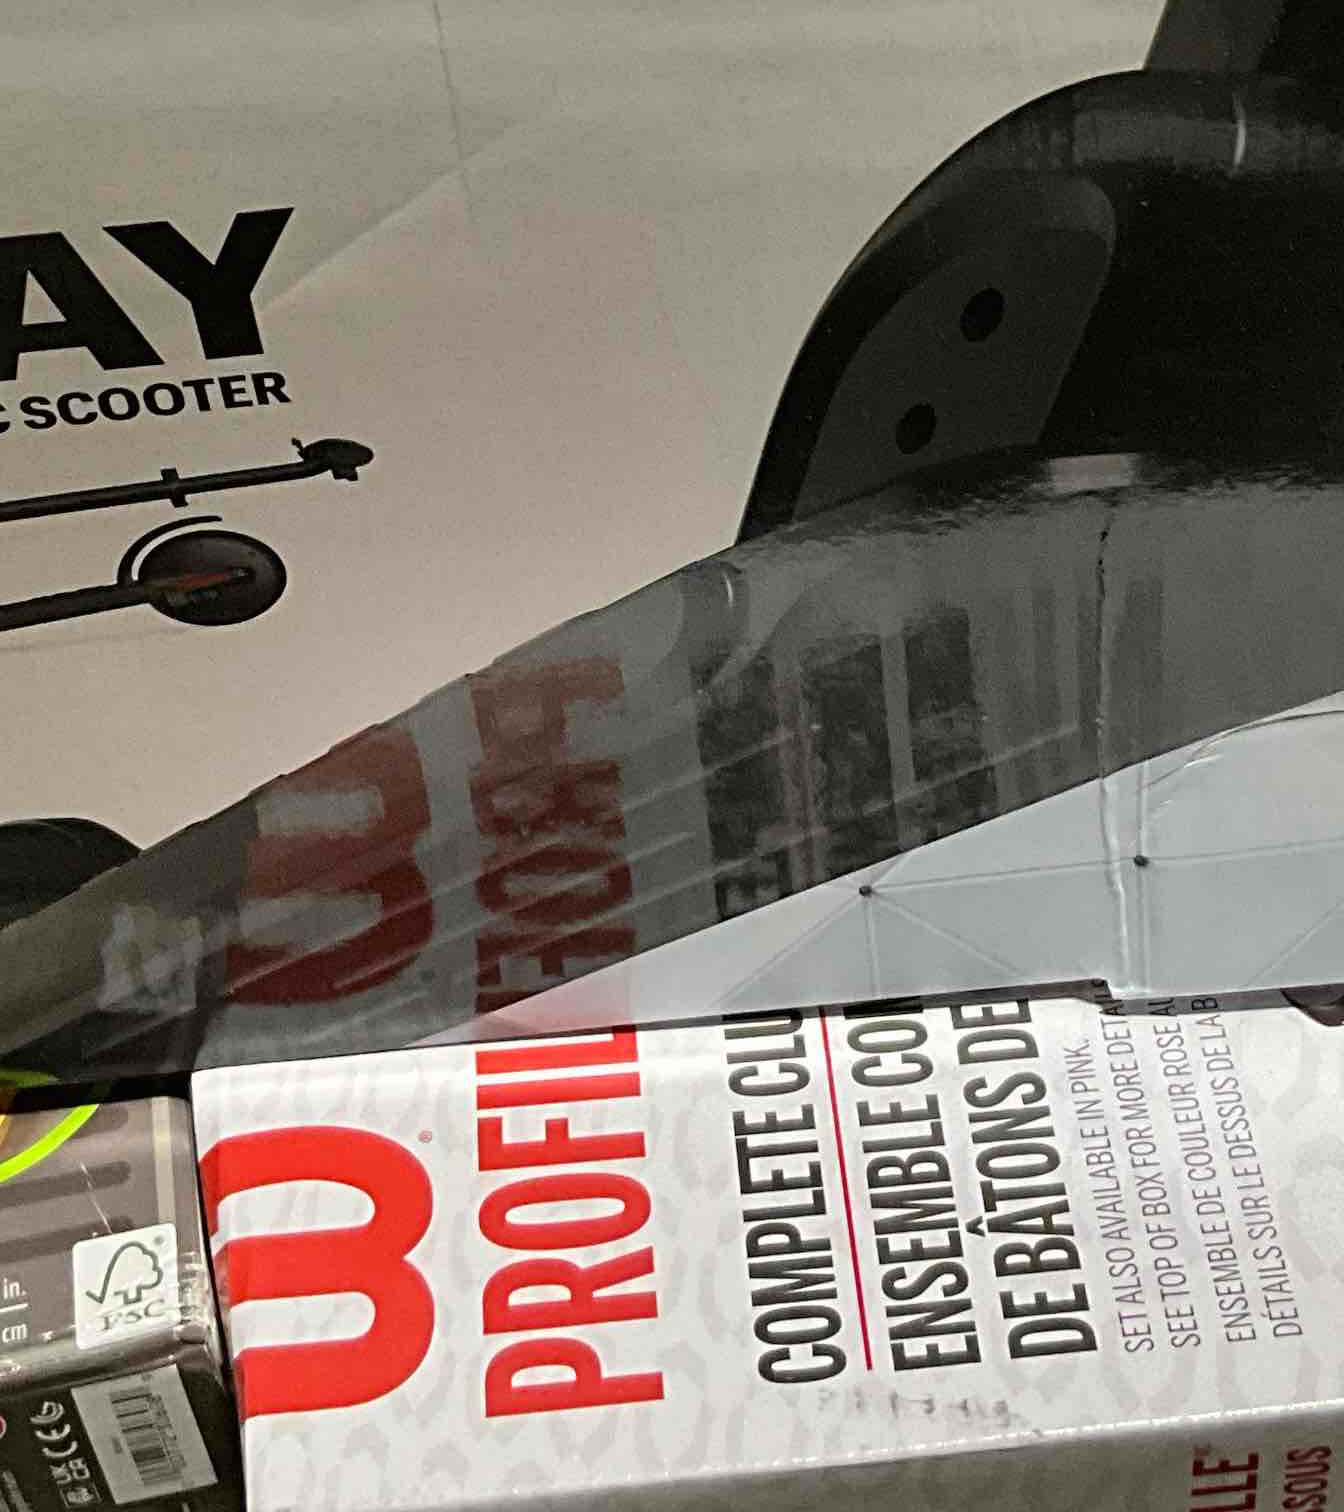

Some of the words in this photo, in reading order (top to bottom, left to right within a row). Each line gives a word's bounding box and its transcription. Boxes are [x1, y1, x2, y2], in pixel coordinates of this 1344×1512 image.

[18, 371, 292, 432] SCOOTER
[946, 997, 1040, 1066] DE
[1152, 1023, 1193, 1078] ROSE
[1194, 1013, 1227, 1041] LA
[1063, 1038, 1100, 1095] PINK.
[1200, 1044, 1235, 1073] DE
[1074, 1099, 1105, 1122] IN
[1109, 1060, 1150, 1120] MORE
[1167, 1081, 1217, 1182] COULEUR
[1209, 1076, 1258, 1161] DESSUS
[963, 1072, 1082, 1278] BÂTONS
[1124, 1126, 1161, 1169] FOR
[1079, 1125, 1132, 1241] AVAILABLE
[1134, 1172, 1172, 1217] BOX
[1191, 1186, 1226, 1217] DE
[1231, 1163, 1265, 1191] LE
[475, 1024, 665, 1420] PROFIL
[732, 1104, 847, 1385] COMPLETE
[856, 1094, 982, 1372] ENSEMBLE
[1144, 1223, 1179, 1250] OF
[1240, 1195, 1278, 1241] SUR
[2, 1277, 27, 1300] in.
[1104, 1246, 1146, 1305] ALSO
[1153, 1256, 1191, 1303] TOP
[1199, 1220, 1258, 1344] ENSEMBLE
[1252, 1245, 1304, 1339] DÉTAILS
[1, 1323, 28, 1344] cm
[100, 1298, 163, 1333] FSC
[999, 1283, 1098, 1360] DE
[1117, 1311, 1155, 1354] SET
[1163, 1304, 1202, 1349] SEE
